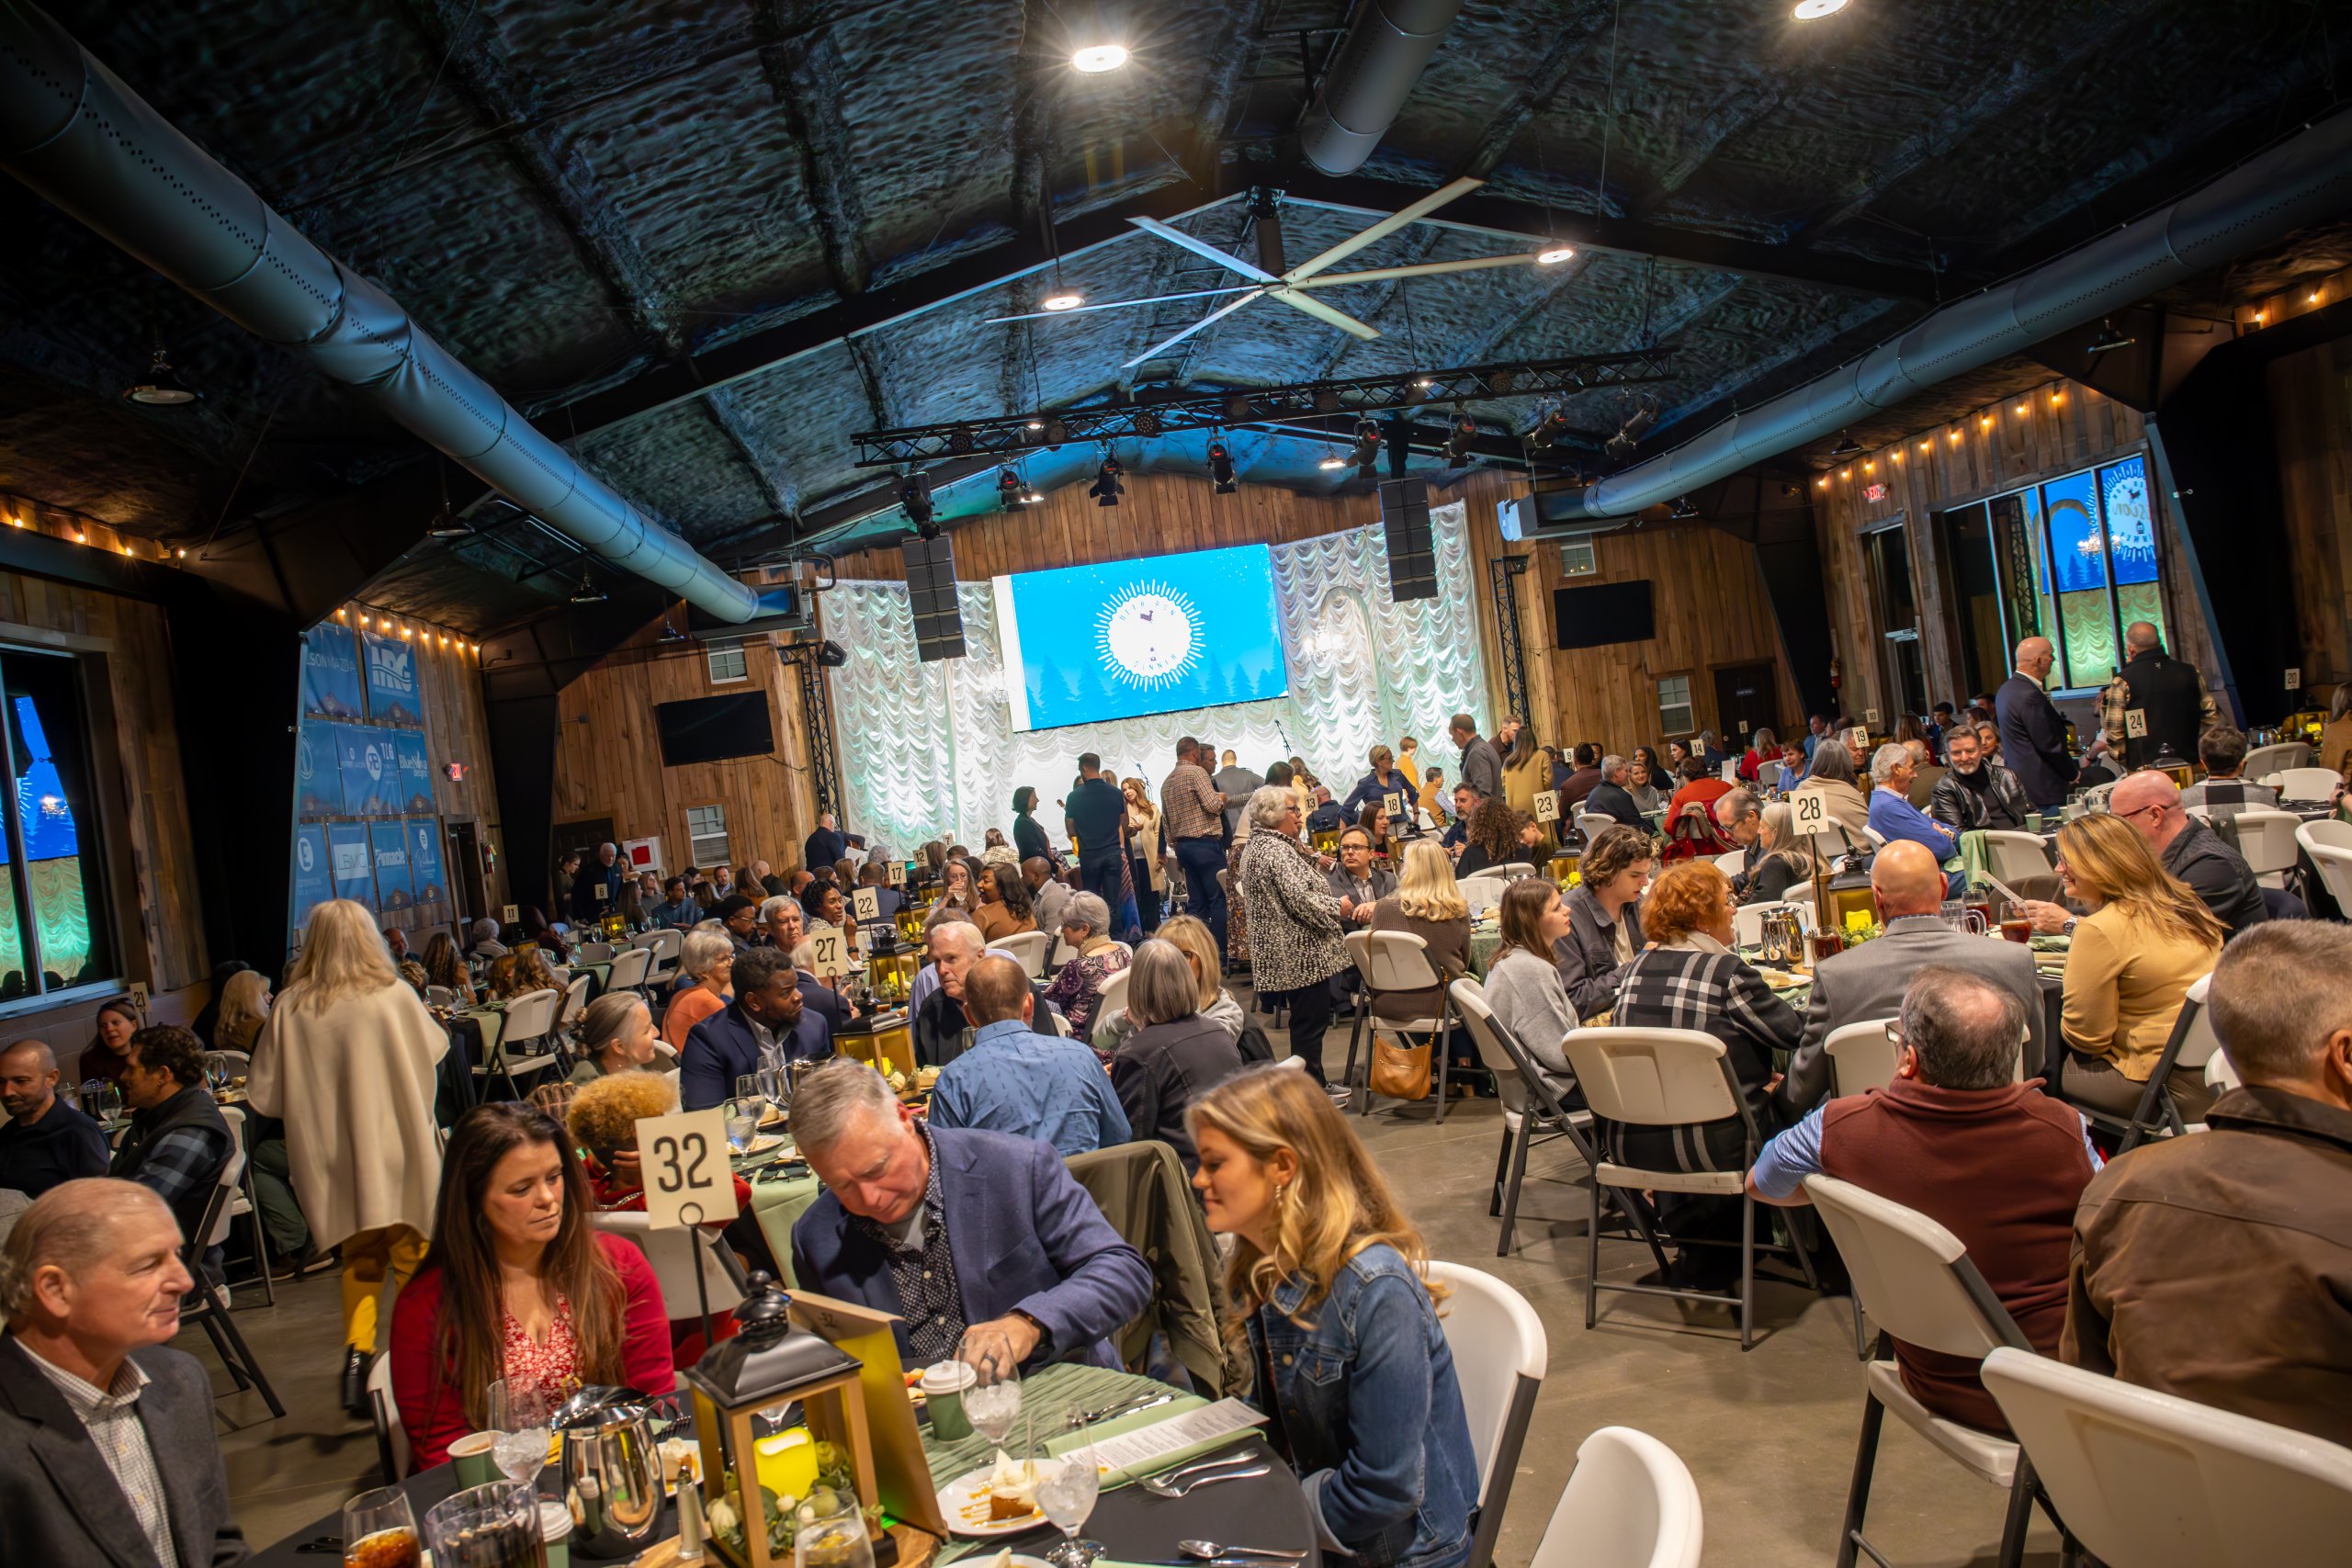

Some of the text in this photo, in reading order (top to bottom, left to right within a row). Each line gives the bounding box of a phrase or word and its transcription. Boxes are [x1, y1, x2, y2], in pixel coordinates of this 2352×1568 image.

[2287, 672, 2297, 684] 20
[1869, 712, 1877, 720] 10
[2130, 715, 2143, 730] 24
[1856, 730, 1866, 743] 19
[1693, 743, 1702, 753] 14
[1567, 751, 1571, 761] 9
[1306, 798, 1316, 809] 13
[1387, 798, 1397, 812] 18
[1537, 796, 1553, 814] 23
[1798, 796, 1821, 821] 28
[945, 837, 949, 845] 7
[915, 852, 925, 863] 12
[891, 867, 902, 881] 17
[600, 888, 605, 897] 6
[858, 897, 874, 914] 22
[507, 908, 514, 918] 11
[816, 937, 836, 963] 27
[134, 991, 145, 1008] 21
[653, 1132, 714, 1193] 32
